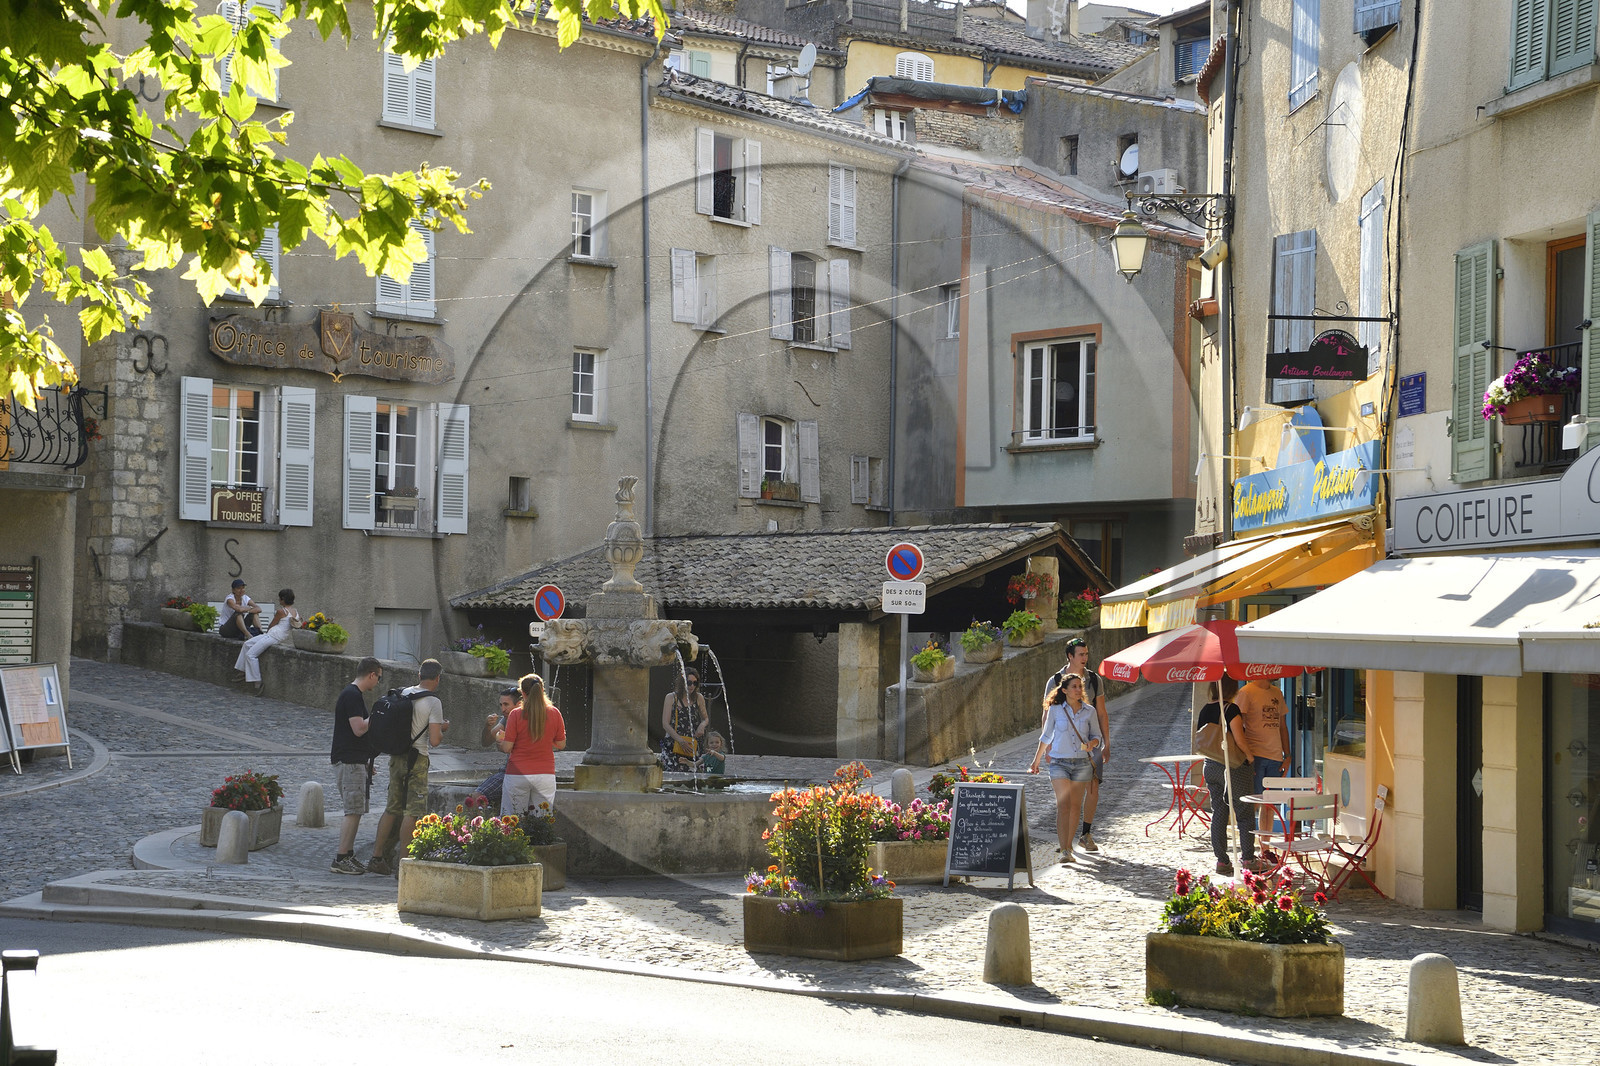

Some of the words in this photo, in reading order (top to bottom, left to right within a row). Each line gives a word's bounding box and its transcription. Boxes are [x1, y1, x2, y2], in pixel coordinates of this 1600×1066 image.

[213, 321, 286, 357] Office
[298, 343, 315, 360] de
[359, 340, 444, 373] tourisme
[1279, 364, 1309, 376] Artisan
[1312, 365, 1353, 379] Boulanger
[235, 491, 263, 502] OFFICE
[251, 503, 262, 513] DE
[221, 510, 262, 523] TOURISME
[1416, 494, 1533, 544] COIFFURE
